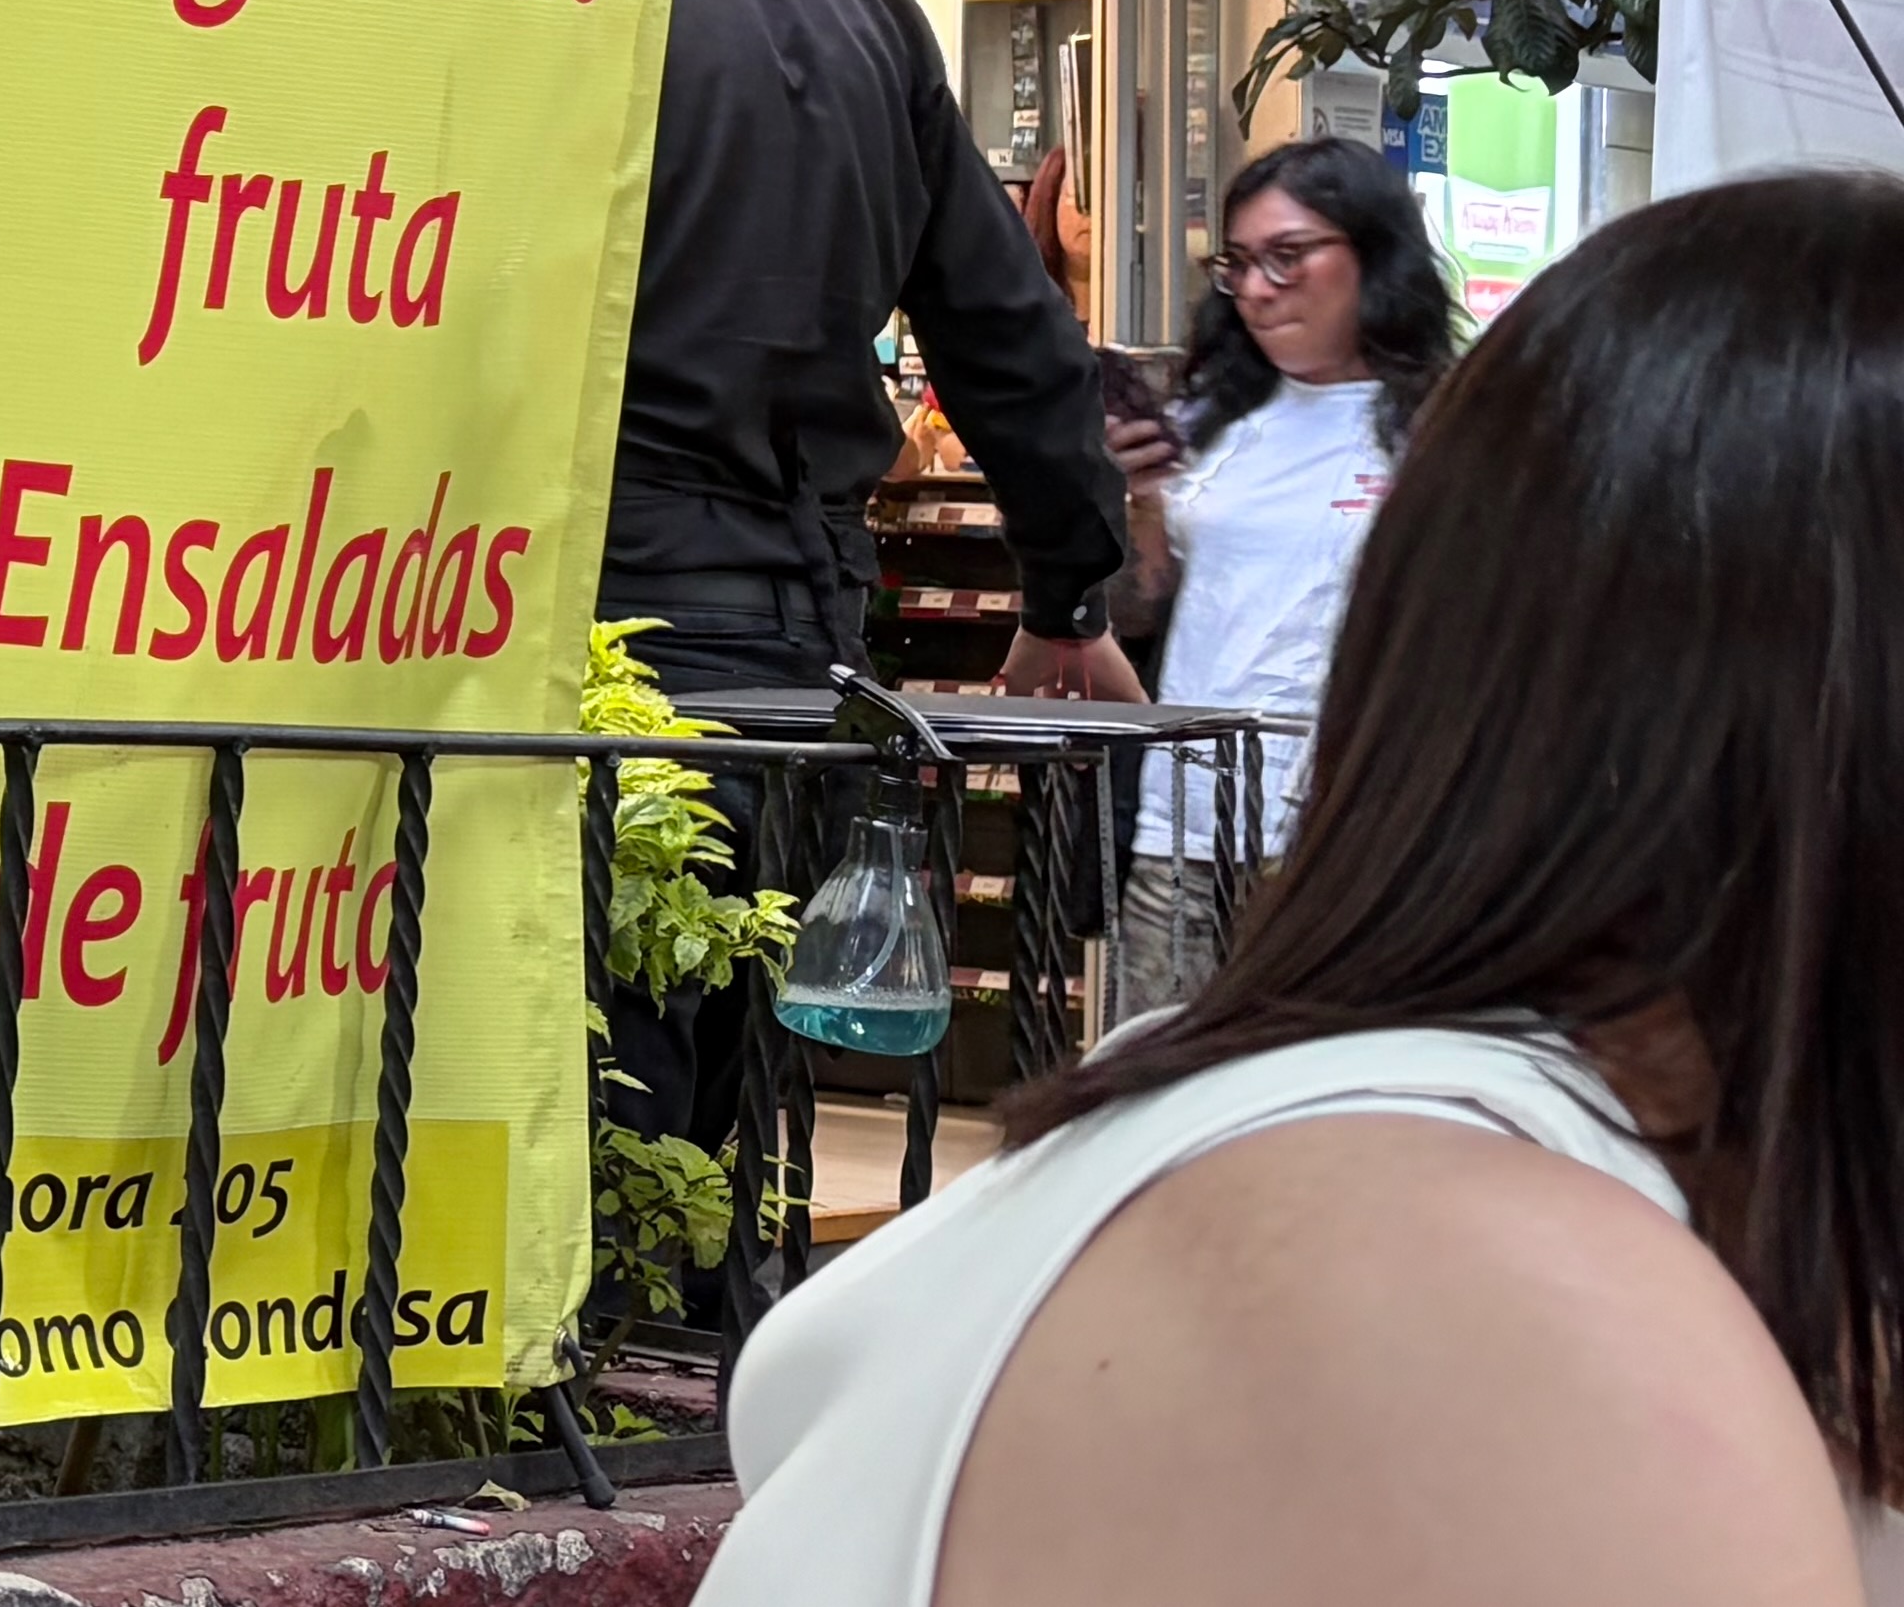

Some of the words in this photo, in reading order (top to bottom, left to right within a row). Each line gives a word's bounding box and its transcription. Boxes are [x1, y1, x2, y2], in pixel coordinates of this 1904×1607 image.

[1382, 127, 1406, 148] VISA
[136, 105, 462, 366] fruta
[169, 1157, 296, 1240] 05
